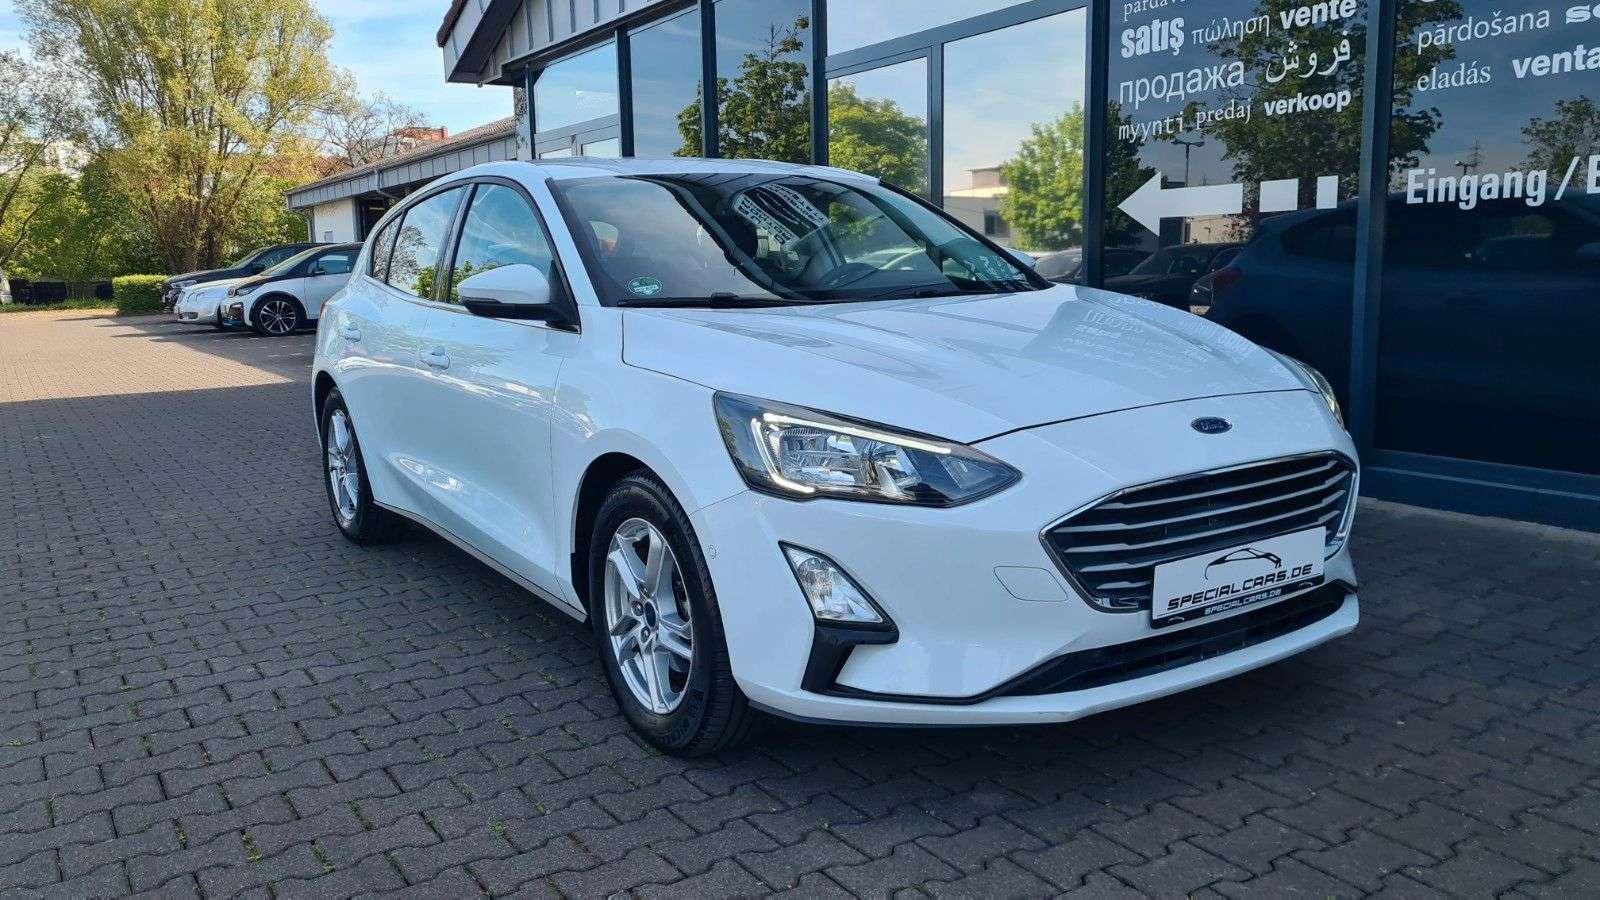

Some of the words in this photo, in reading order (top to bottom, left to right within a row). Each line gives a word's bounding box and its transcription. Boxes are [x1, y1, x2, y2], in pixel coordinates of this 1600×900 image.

[1191, 14, 1270, 45] πώληση
[1280, 0, 1356, 30] vente
[1418, 9, 1550, 55] pārdošana
[1121, 17, 1185, 58] satış
[1265, 31, 1350, 83] فروش
[1119, 60, 1245, 109] продажа
[1417, 60, 1491, 92] eladás
[1118, 111, 1184, 144] myynti
[1196, 98, 1251, 130] predaj
[1264, 90, 1351, 116] verkoop
[1406, 168, 1547, 210] Eingang
[1167, 563, 1313, 611] SPECIALCARS.DE
